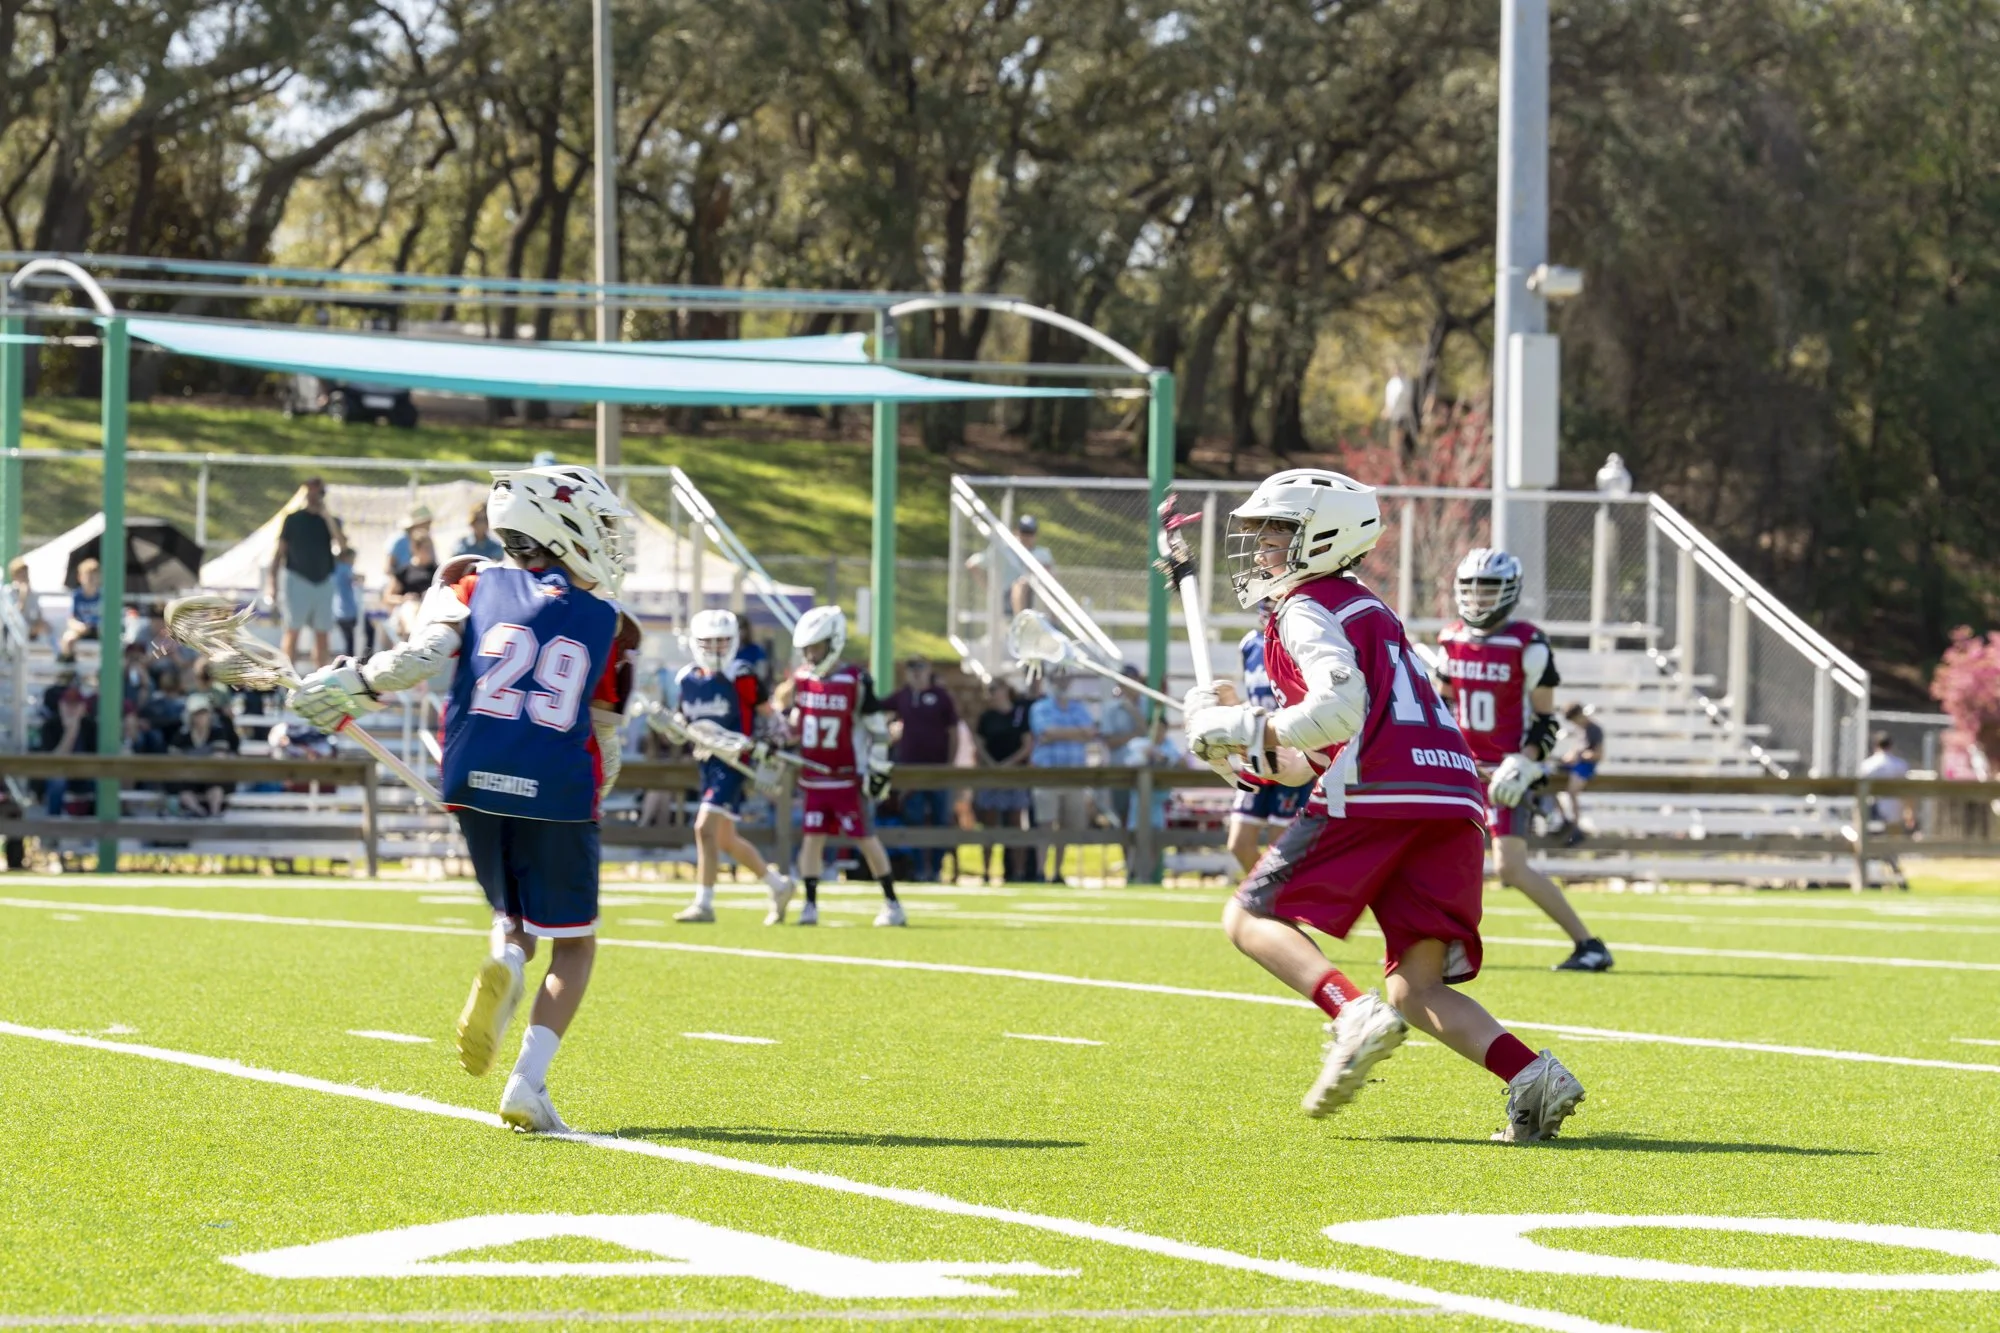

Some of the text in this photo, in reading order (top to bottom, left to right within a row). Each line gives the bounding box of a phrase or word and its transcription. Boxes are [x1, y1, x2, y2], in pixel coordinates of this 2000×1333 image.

[468, 622, 591, 733] 29
[1449, 658, 1511, 682] EAGLES
[1458, 688, 1496, 732] 10
[802, 714, 841, 749] 87
[1411, 748, 1478, 778] GORDON
